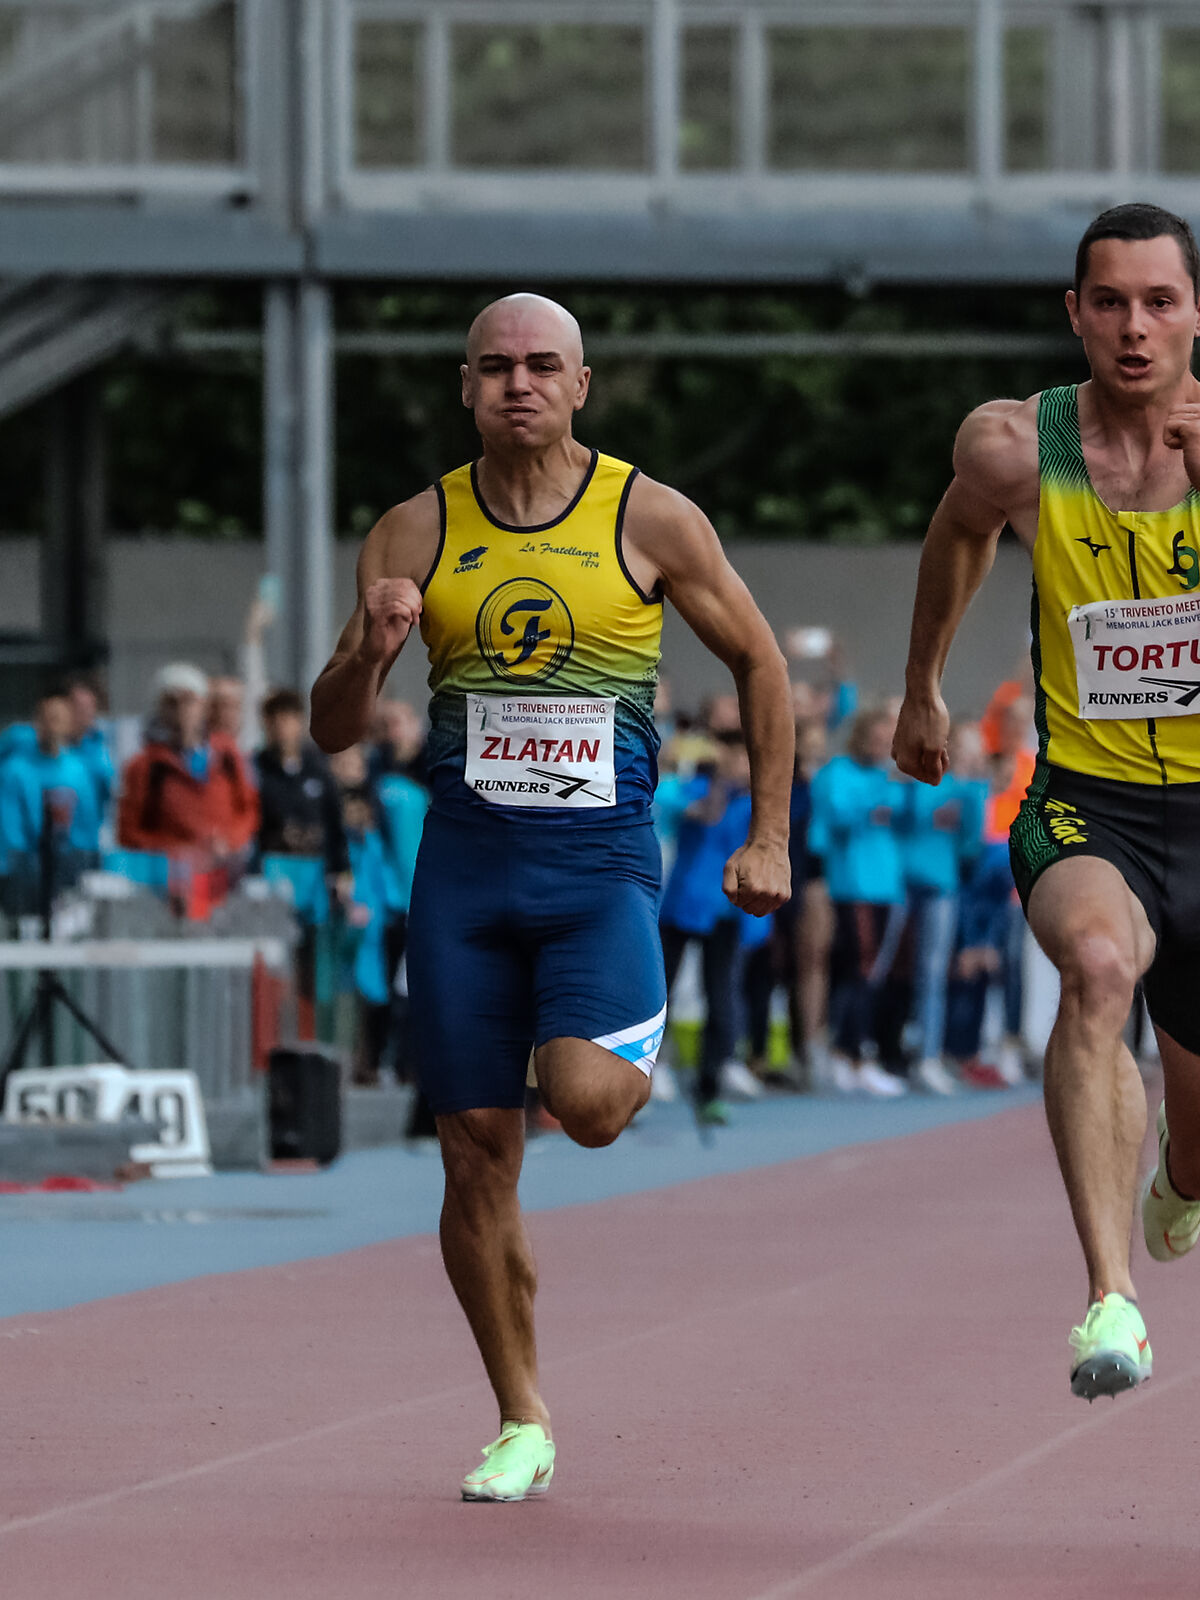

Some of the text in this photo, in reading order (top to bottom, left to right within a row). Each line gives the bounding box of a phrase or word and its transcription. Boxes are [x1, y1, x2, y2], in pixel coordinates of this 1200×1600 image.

[519, 542, 599, 560] La Fratellanza
[453, 562, 483, 574] KARHU
[1120, 603, 1173, 618] TRIVENETO
[1106, 620, 1150, 630] MEMORIAL
[1151, 620, 1173, 628] JACK
[1088, 692, 1168, 705] RUNNERS
[517, 703, 566, 713] TRIVENETO
[567, 704, 606, 714] MEETING
[502, 716, 606, 725] MEMORIAL JACK BENVENUTI
[480, 736, 600, 763] ZLATAN
[474, 780, 550, 794] RUNNERS
